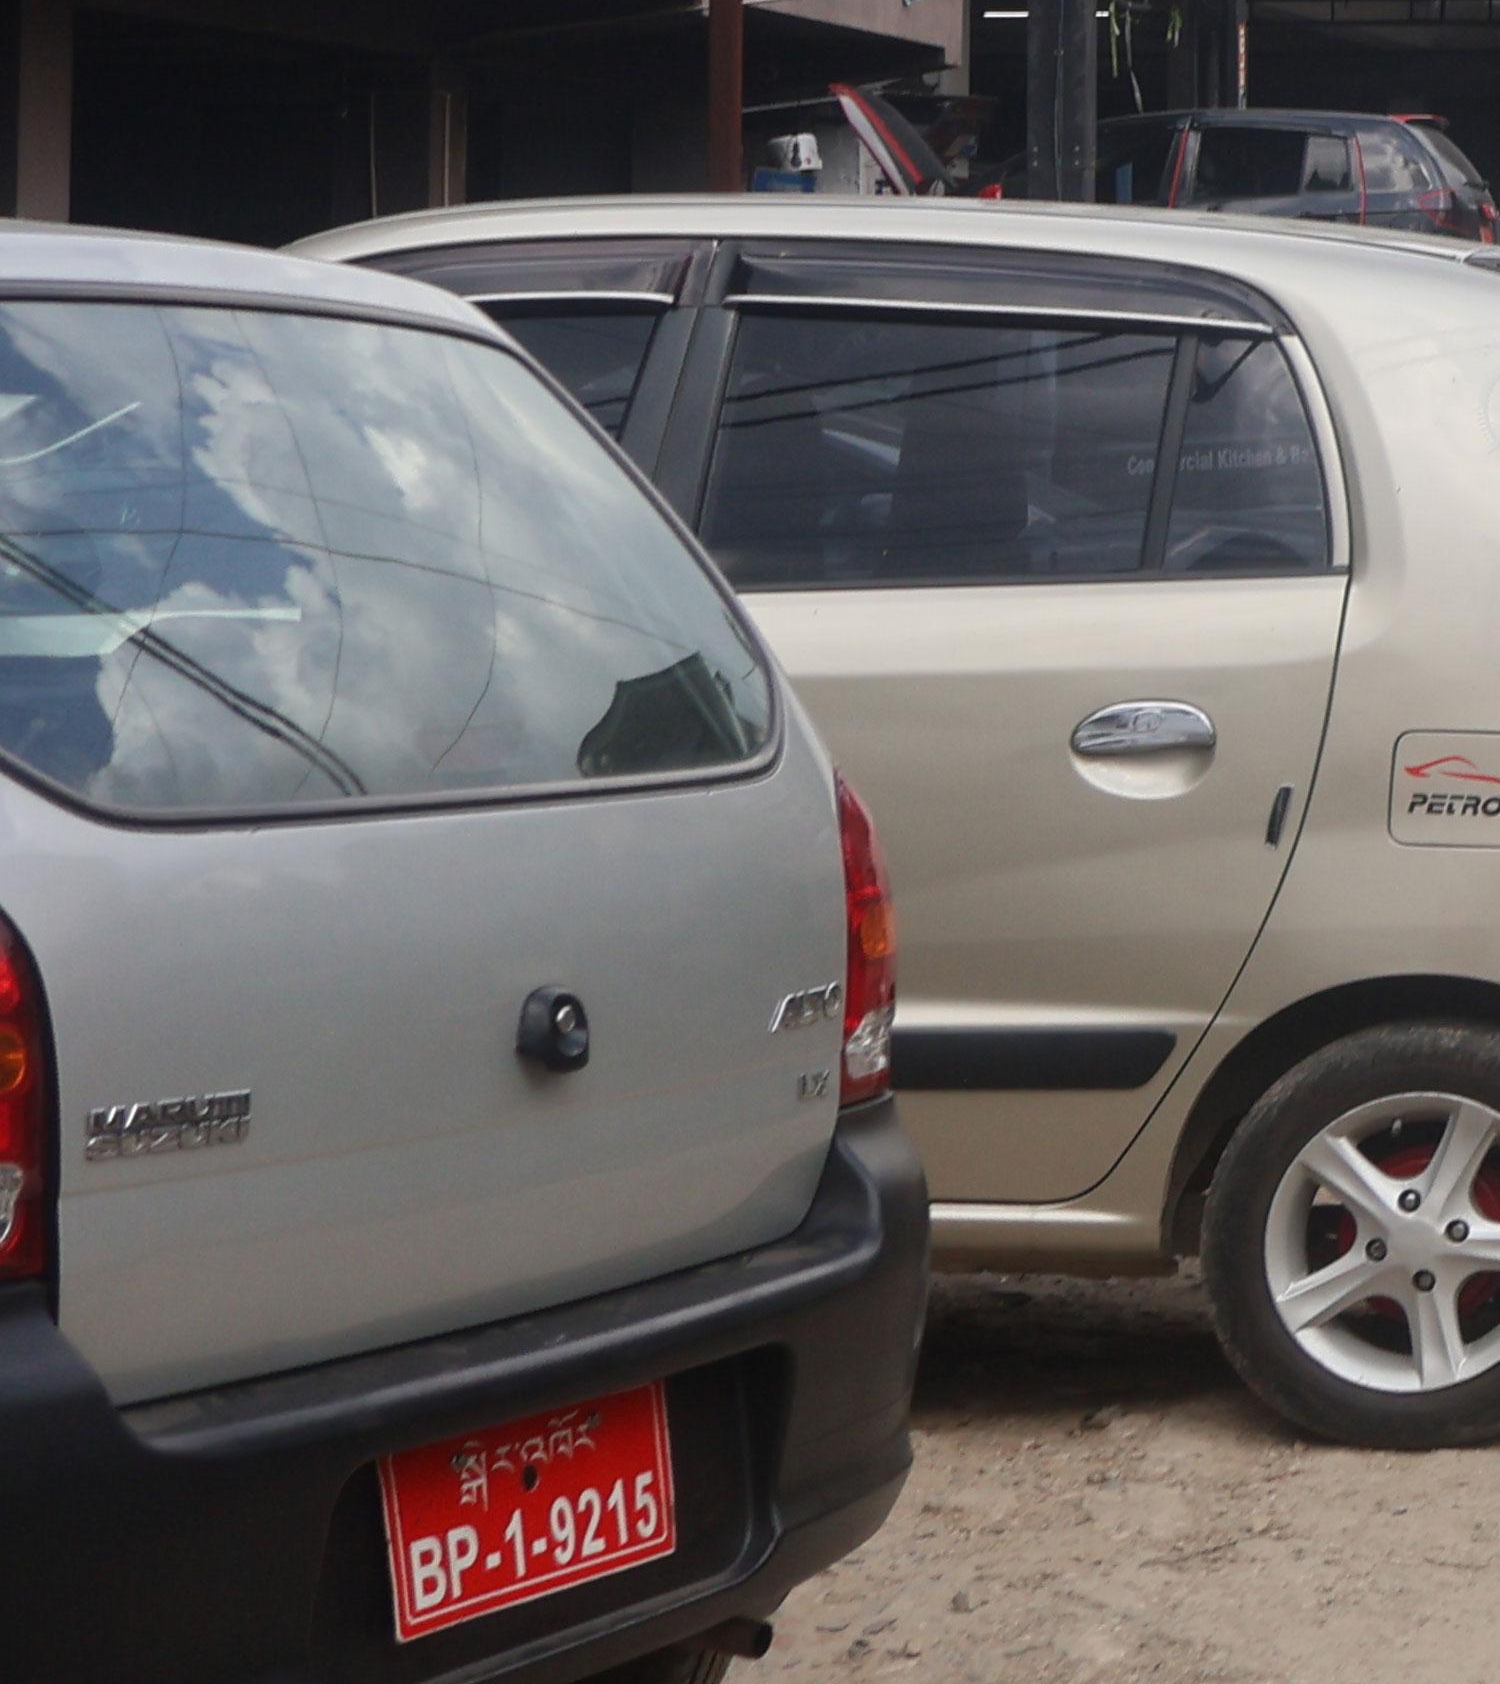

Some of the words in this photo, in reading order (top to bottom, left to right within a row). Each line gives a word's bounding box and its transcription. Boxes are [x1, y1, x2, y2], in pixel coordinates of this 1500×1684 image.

[767, 980, 841, 1033] ALTO
[88, 1088, 251, 1136] MARUTI
[85, 1115, 251, 1161] SUZUKI
[409, 1470, 658, 1611] BP-1-9215
